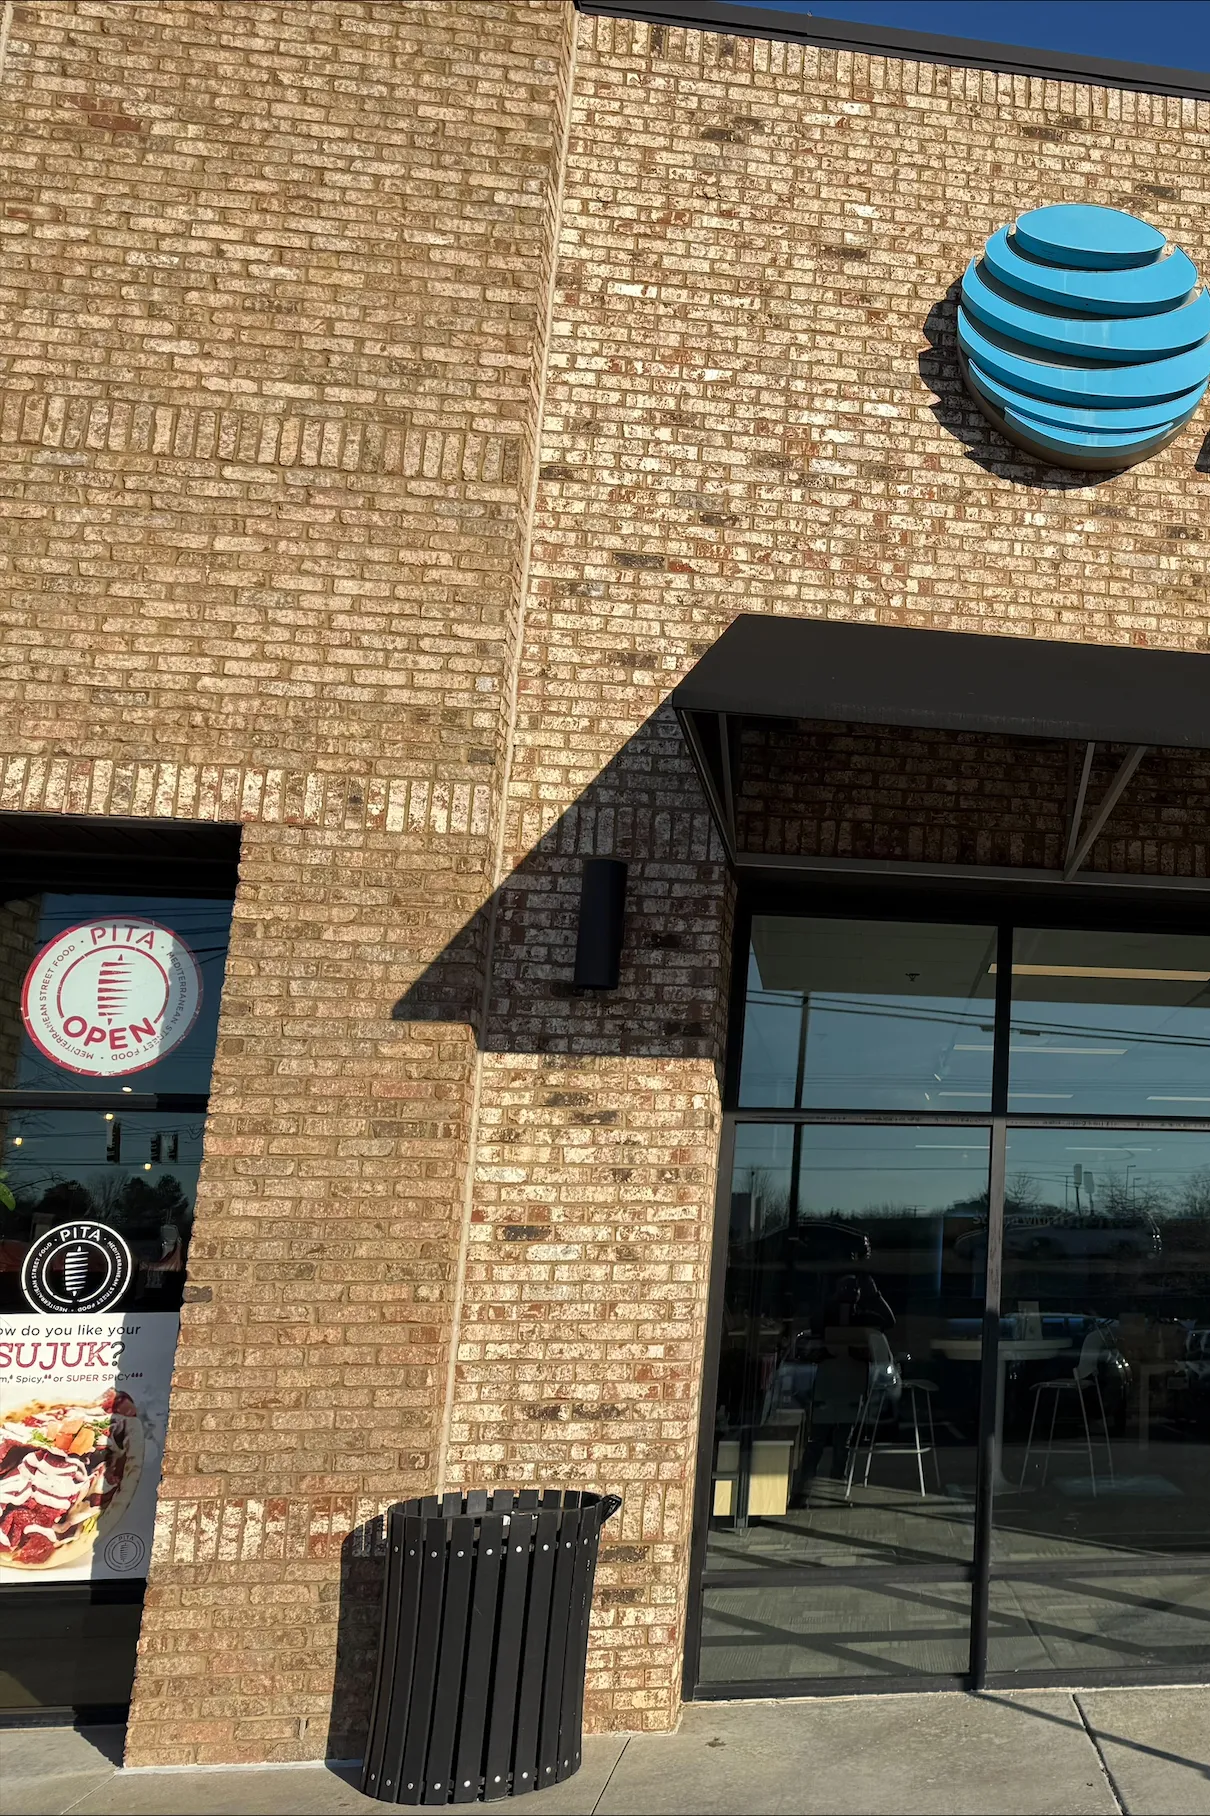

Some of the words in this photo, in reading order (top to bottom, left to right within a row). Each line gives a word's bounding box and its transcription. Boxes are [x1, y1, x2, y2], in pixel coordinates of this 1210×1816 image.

[89, 924, 155, 950] PITA
[52, 944, 76, 967] FOOD
[39, 968, 55, 1001] STREET
[166, 951, 188, 1025] MEDITERRANEAN
[40, 1004, 95, 1060] MEDITERRANEAN
[63, 1015, 157, 1050] OPEN
[143, 1026, 173, 1052] STREET
[111, 1048, 140, 1061] FOOD
[60, 1226, 101, 1242] PITA
[21, 1325, 40, 1336] do
[45, 1327, 72, 1337] you
[77, 1324, 103, 1335] like
[107, 1326, 141, 1337] your
[0, 1341, 126, 1370] SUJUK?
[66, 1374, 99, 1382] SUPER
[101, 1373, 131, 1382] SPICY
